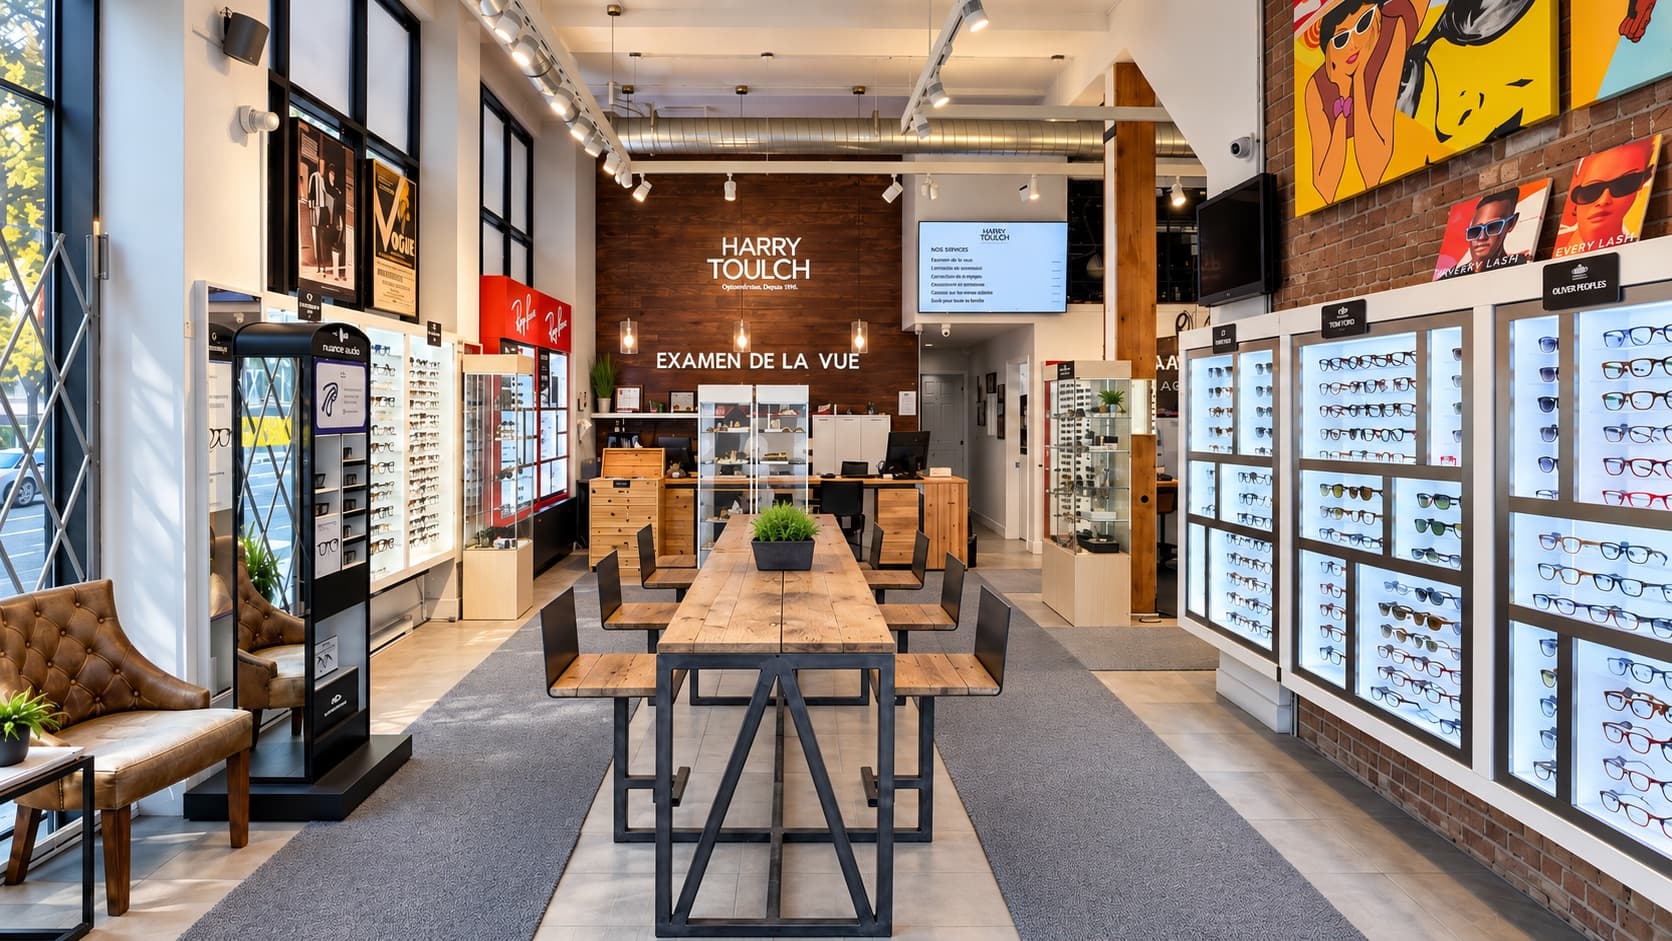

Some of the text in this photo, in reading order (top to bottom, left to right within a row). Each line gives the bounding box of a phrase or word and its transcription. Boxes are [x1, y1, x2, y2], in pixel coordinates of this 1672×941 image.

[722, 236, 802, 257] HARRY
[1555, 231, 1635, 257] EVERY LASH
[706, 258, 810, 280] TOULCH
[1486, 254, 1519, 269] LASH
[656, 352, 860, 369] EXAMEN DE LA VUE
[1156, 355, 1179, 370] AA
